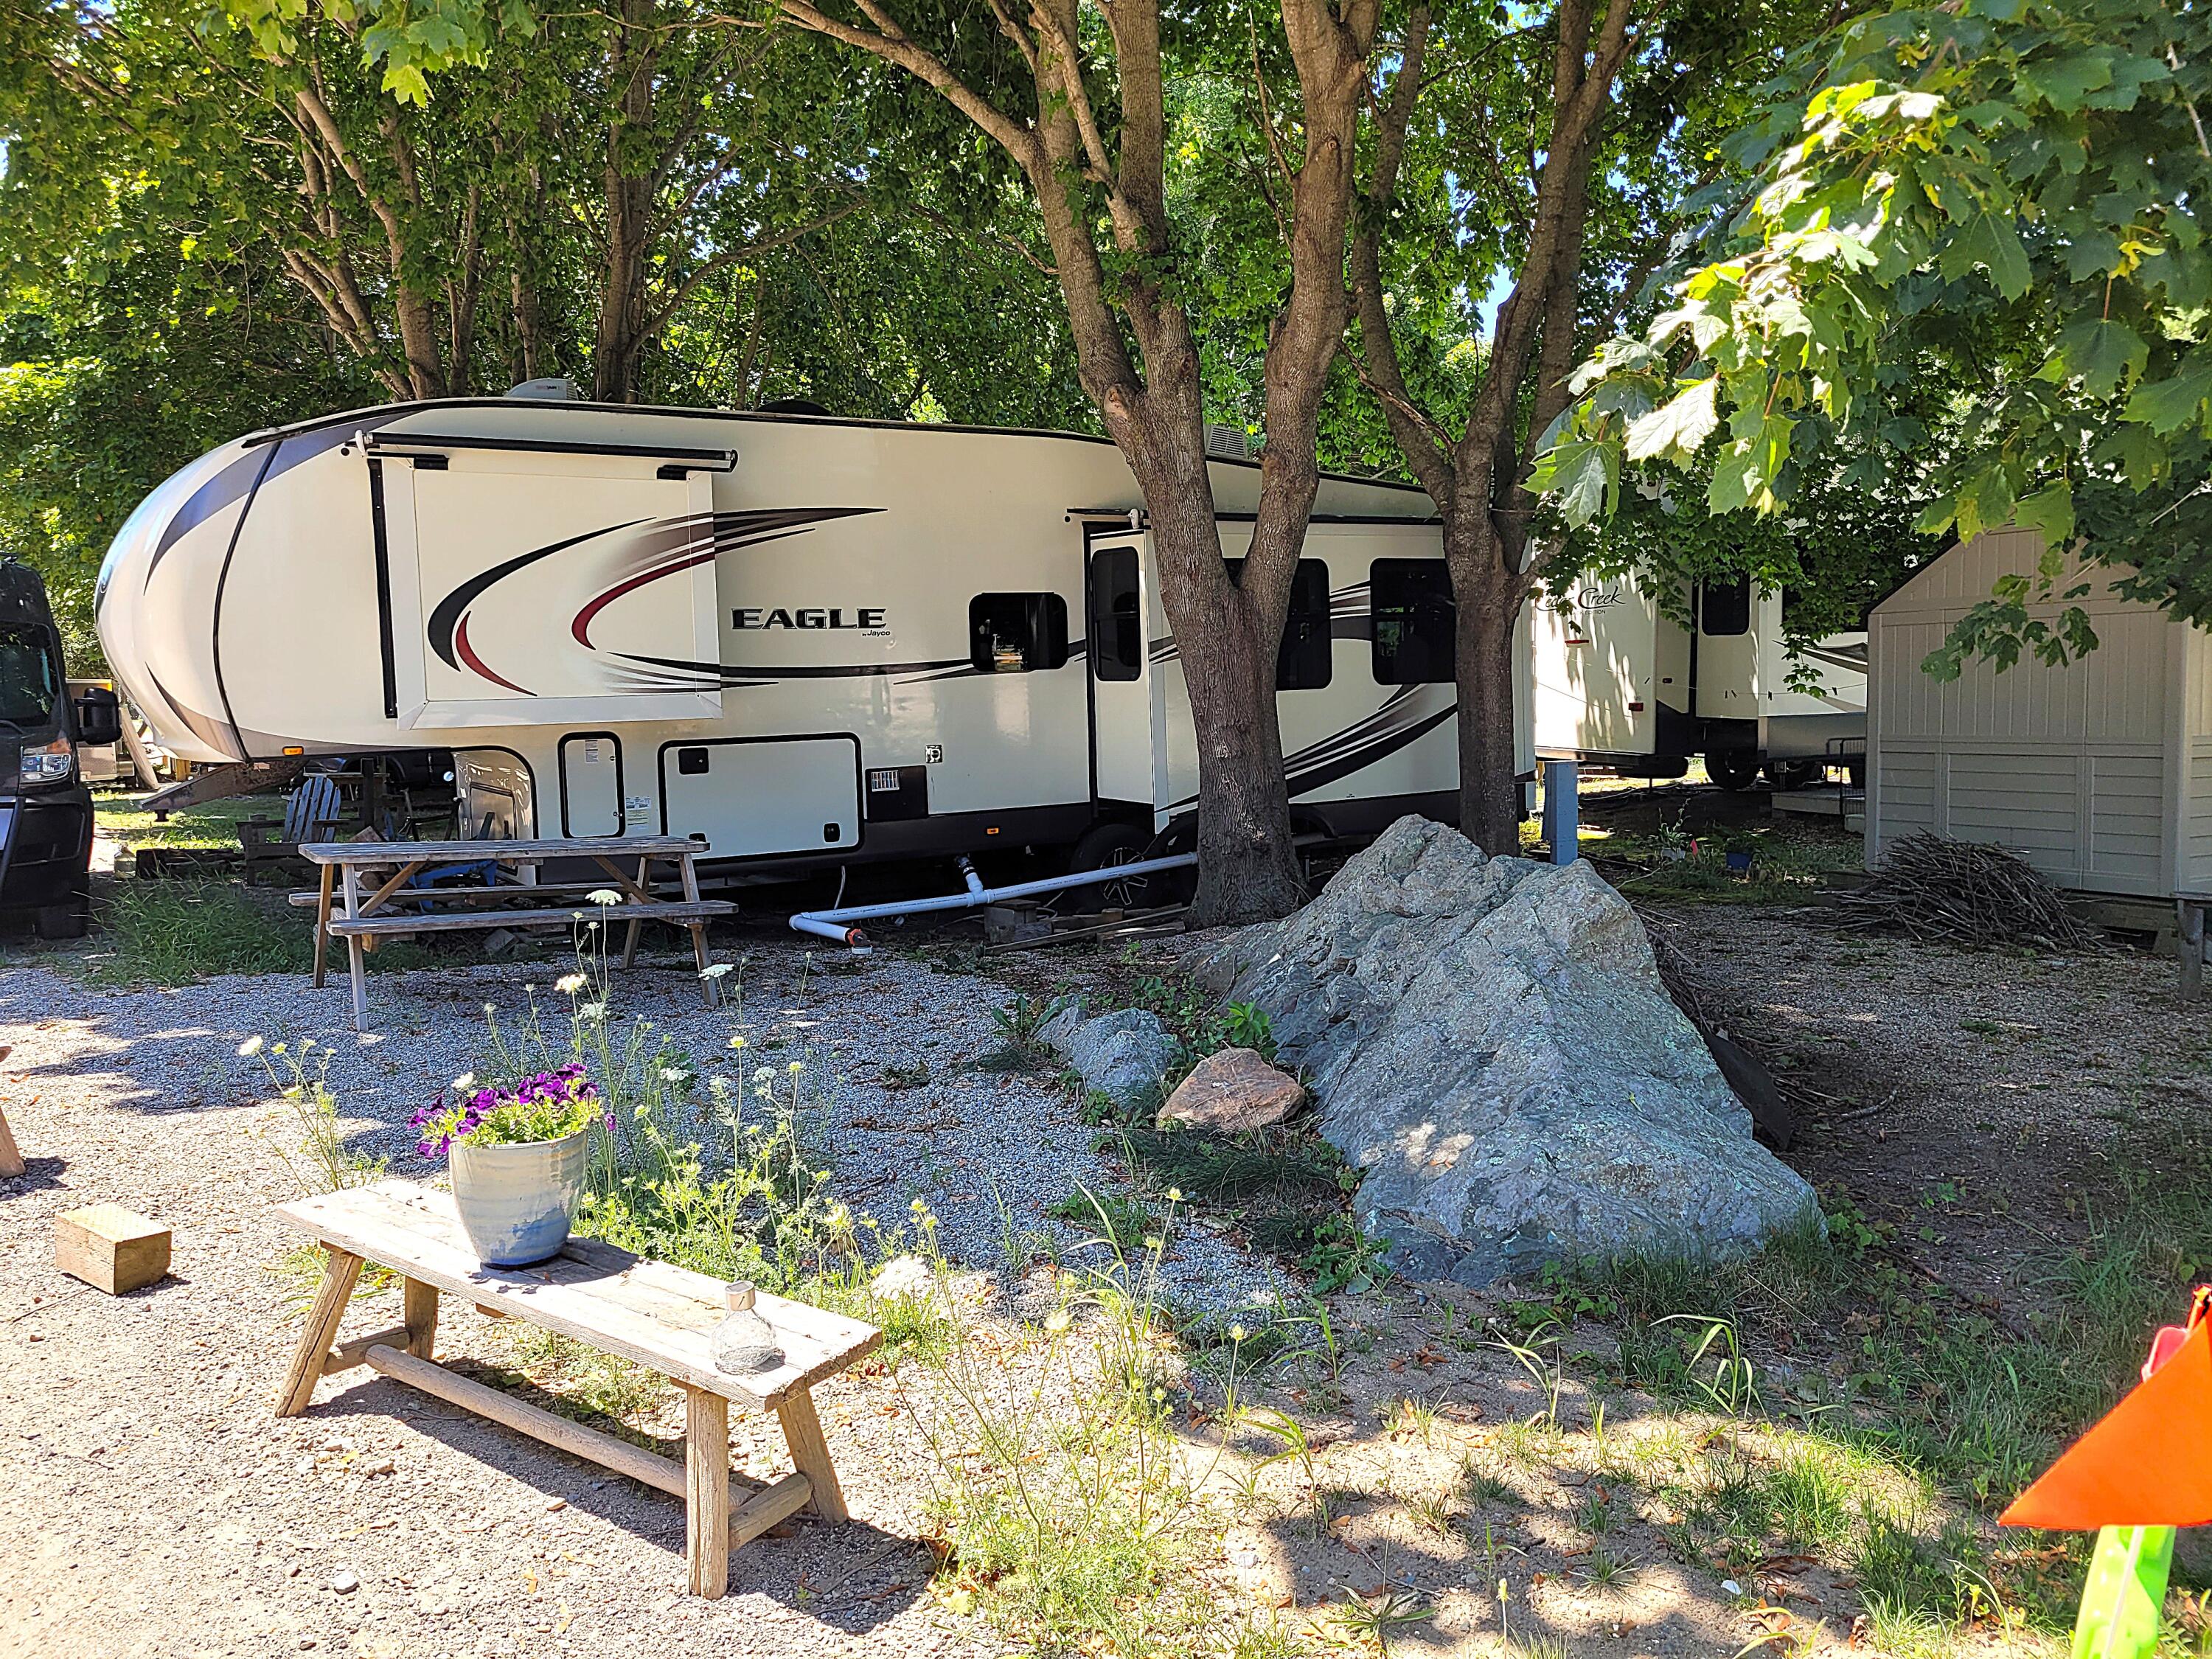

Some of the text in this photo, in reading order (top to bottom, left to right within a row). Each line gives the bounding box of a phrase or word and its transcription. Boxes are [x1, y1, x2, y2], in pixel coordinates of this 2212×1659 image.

[1534, 585, 1626, 611] Ced Creek
[731, 608, 886, 629] EAGLE
[867, 629, 891, 637] Jayco
